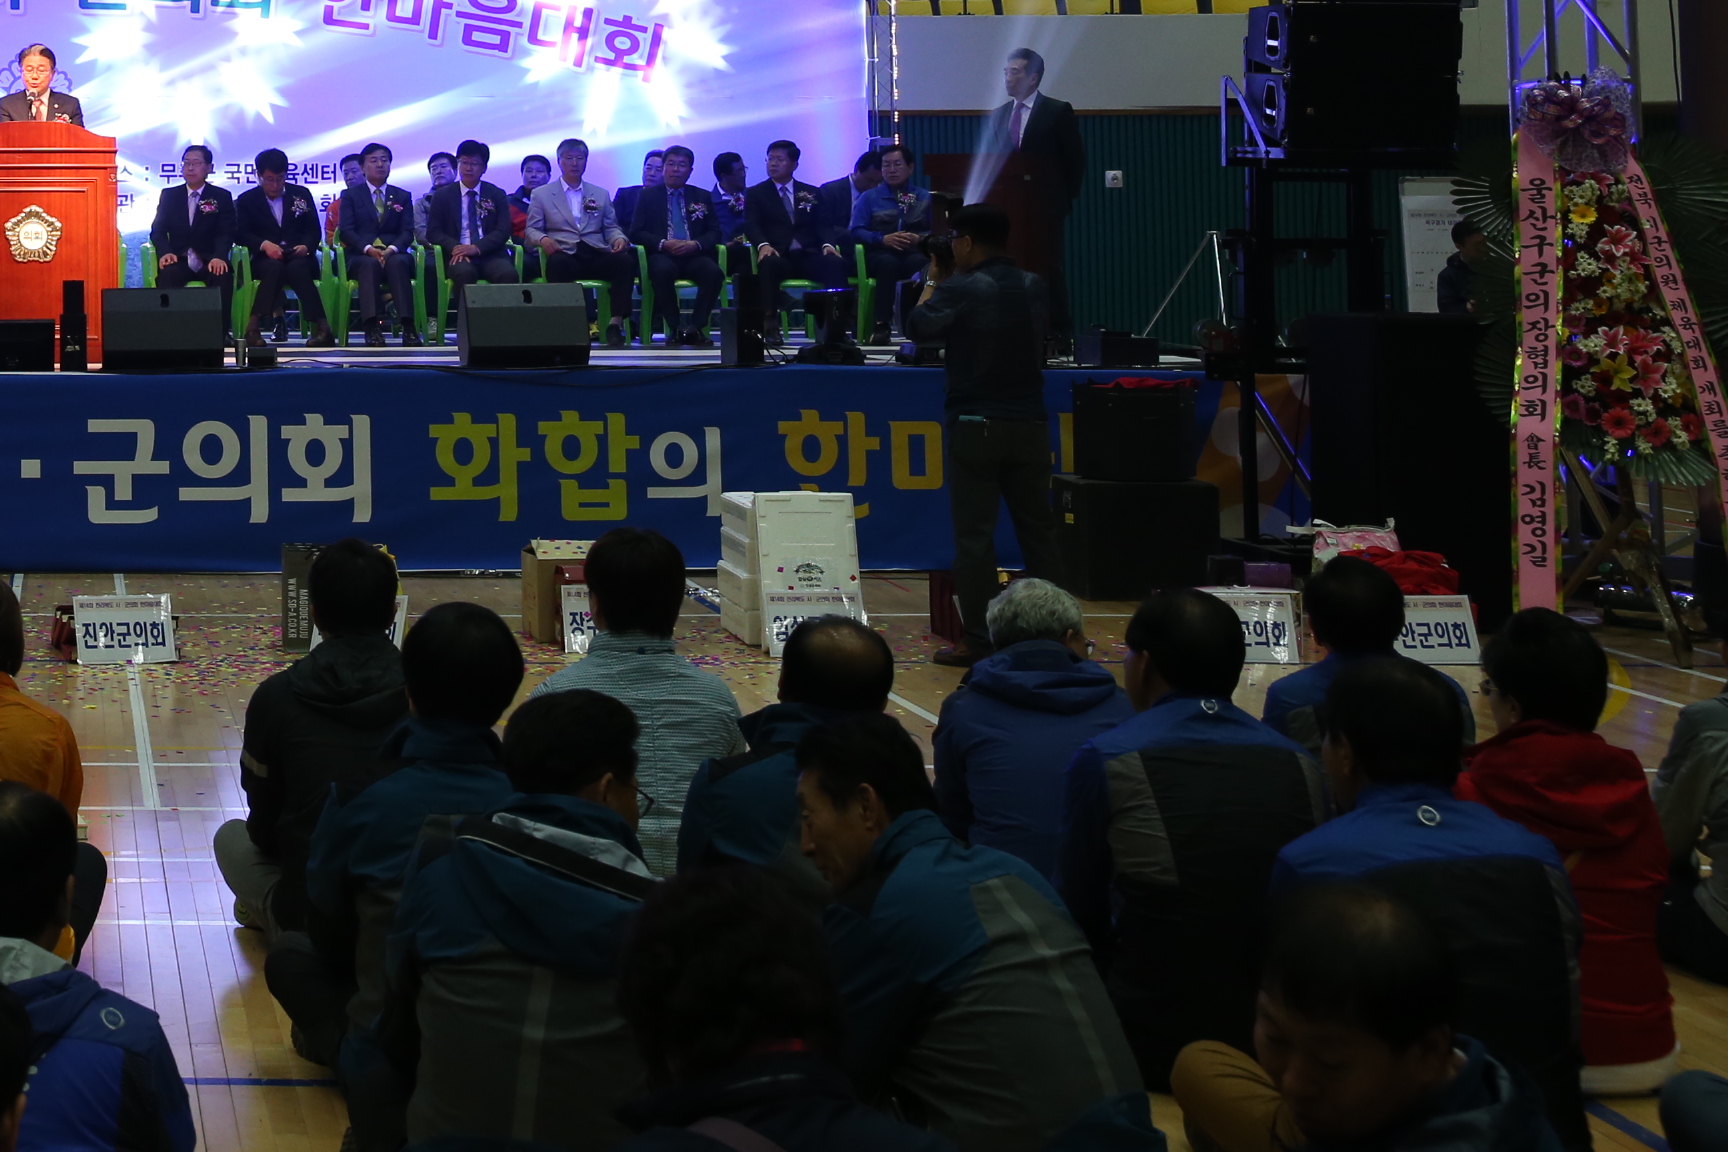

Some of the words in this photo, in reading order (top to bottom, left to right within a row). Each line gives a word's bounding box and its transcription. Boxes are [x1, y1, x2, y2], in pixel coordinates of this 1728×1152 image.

[23, 230, 43, 242] 의회
[1627, 173, 1655, 210] 전북
[1669, 297, 1708, 373] 체육대회
[1519, 177, 1556, 423] 울산구군의장협의회
[428, 410, 722, 521] 화합의
[1521, 480, 1548, 568] 김영길
[82, 621, 166, 649] 진안군의회
[1394, 621, 1472, 649] 안군의회
